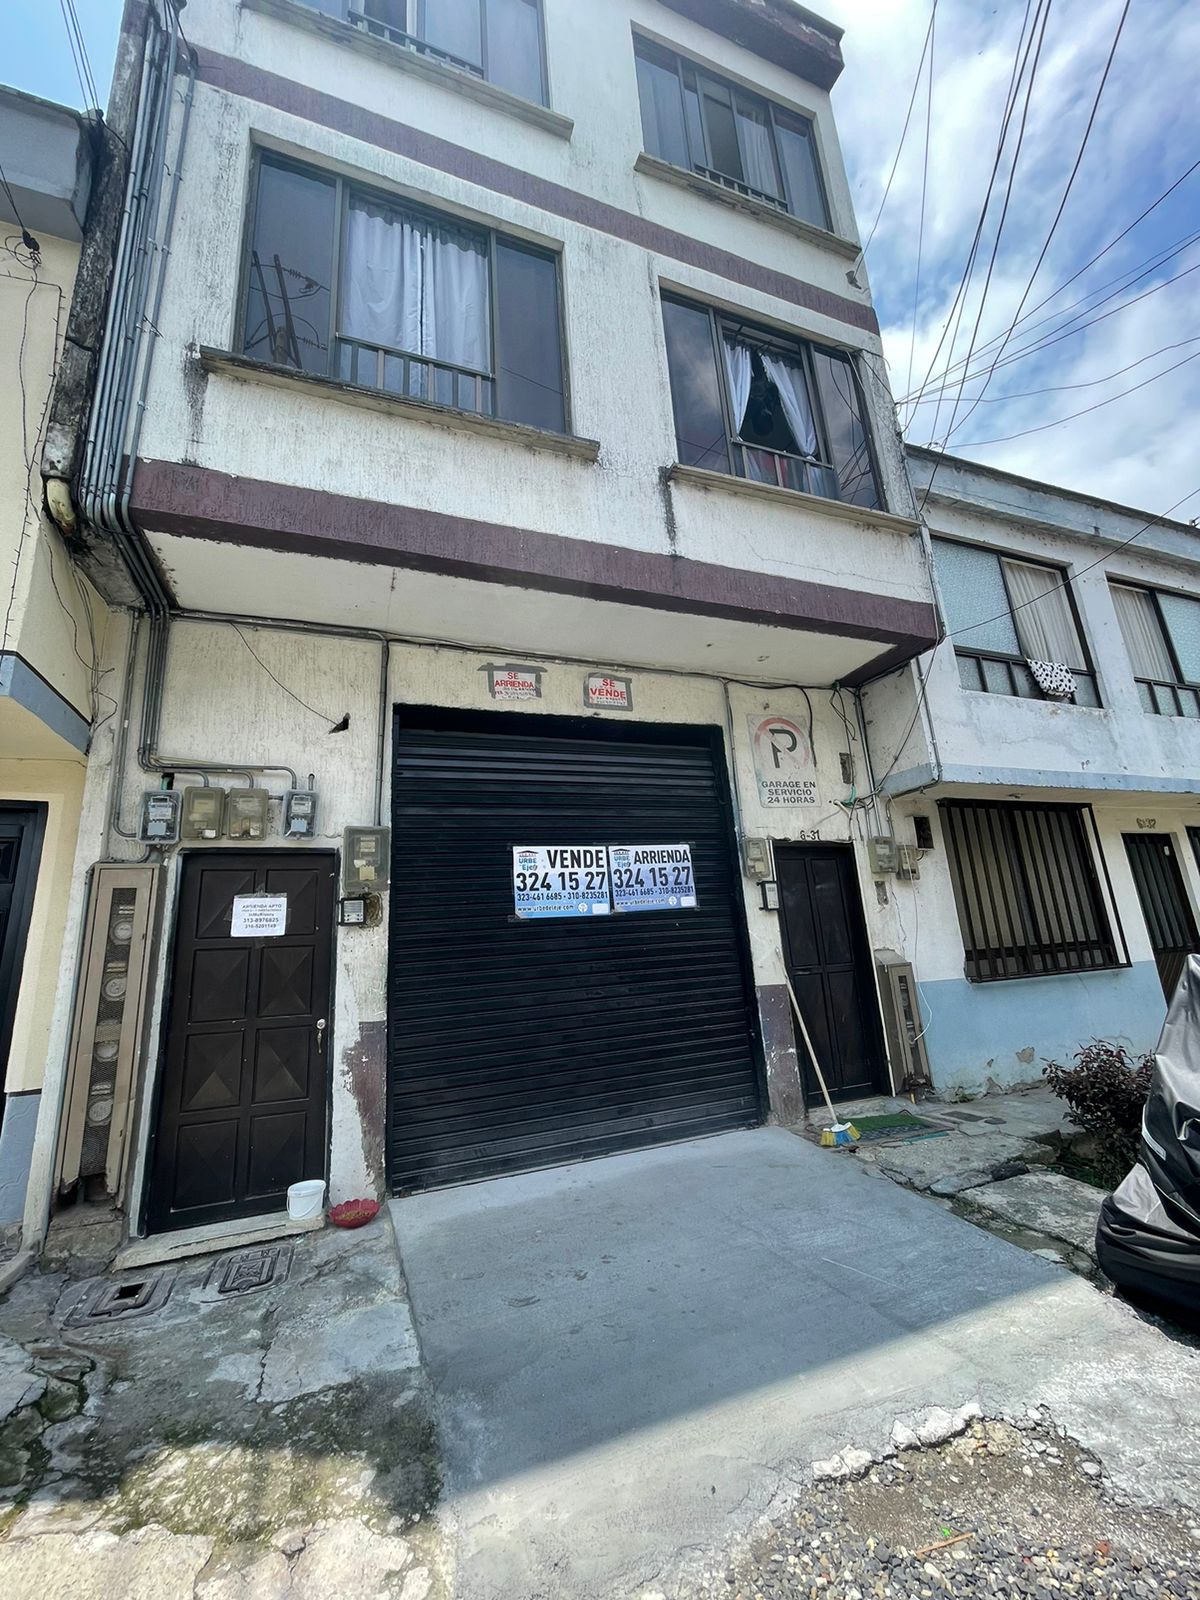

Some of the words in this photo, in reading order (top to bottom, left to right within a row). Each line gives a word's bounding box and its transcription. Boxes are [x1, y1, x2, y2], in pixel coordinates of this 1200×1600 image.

[507, 671, 519, 680] SE
[494, 679, 535, 689] ARRIENDA
[602, 678, 615, 687] SE
[590, 687, 626, 699] VENDE
[761, 780, 801, 789] GARAGE
[803, 781, 816, 789] EN
[768, 788, 812, 796] SERVICIO
[767, 796, 780, 804] 24
[783, 796, 816, 804] HORAS
[799, 829, 820, 841] 6-31
[546, 849, 605, 869] VENDE
[633, 849, 691, 865] ARRIENDA
[516, 871, 552, 892] 324
[558, 871, 580, 891] 15
[585, 871, 606, 890] 27
[613, 867, 645, 889] 324
[649, 867, 669, 887] 15
[672, 866, 691, 886] 27
[517, 892, 545, 902] 323-461
[546, 892, 563, 901] 6685
[567, 891, 608, 900] 310-8235281
[615, 888, 639, 897] 323-461
[640, 888, 654, 896] 6685
[658, 885, 694, 895] 310-8235281
